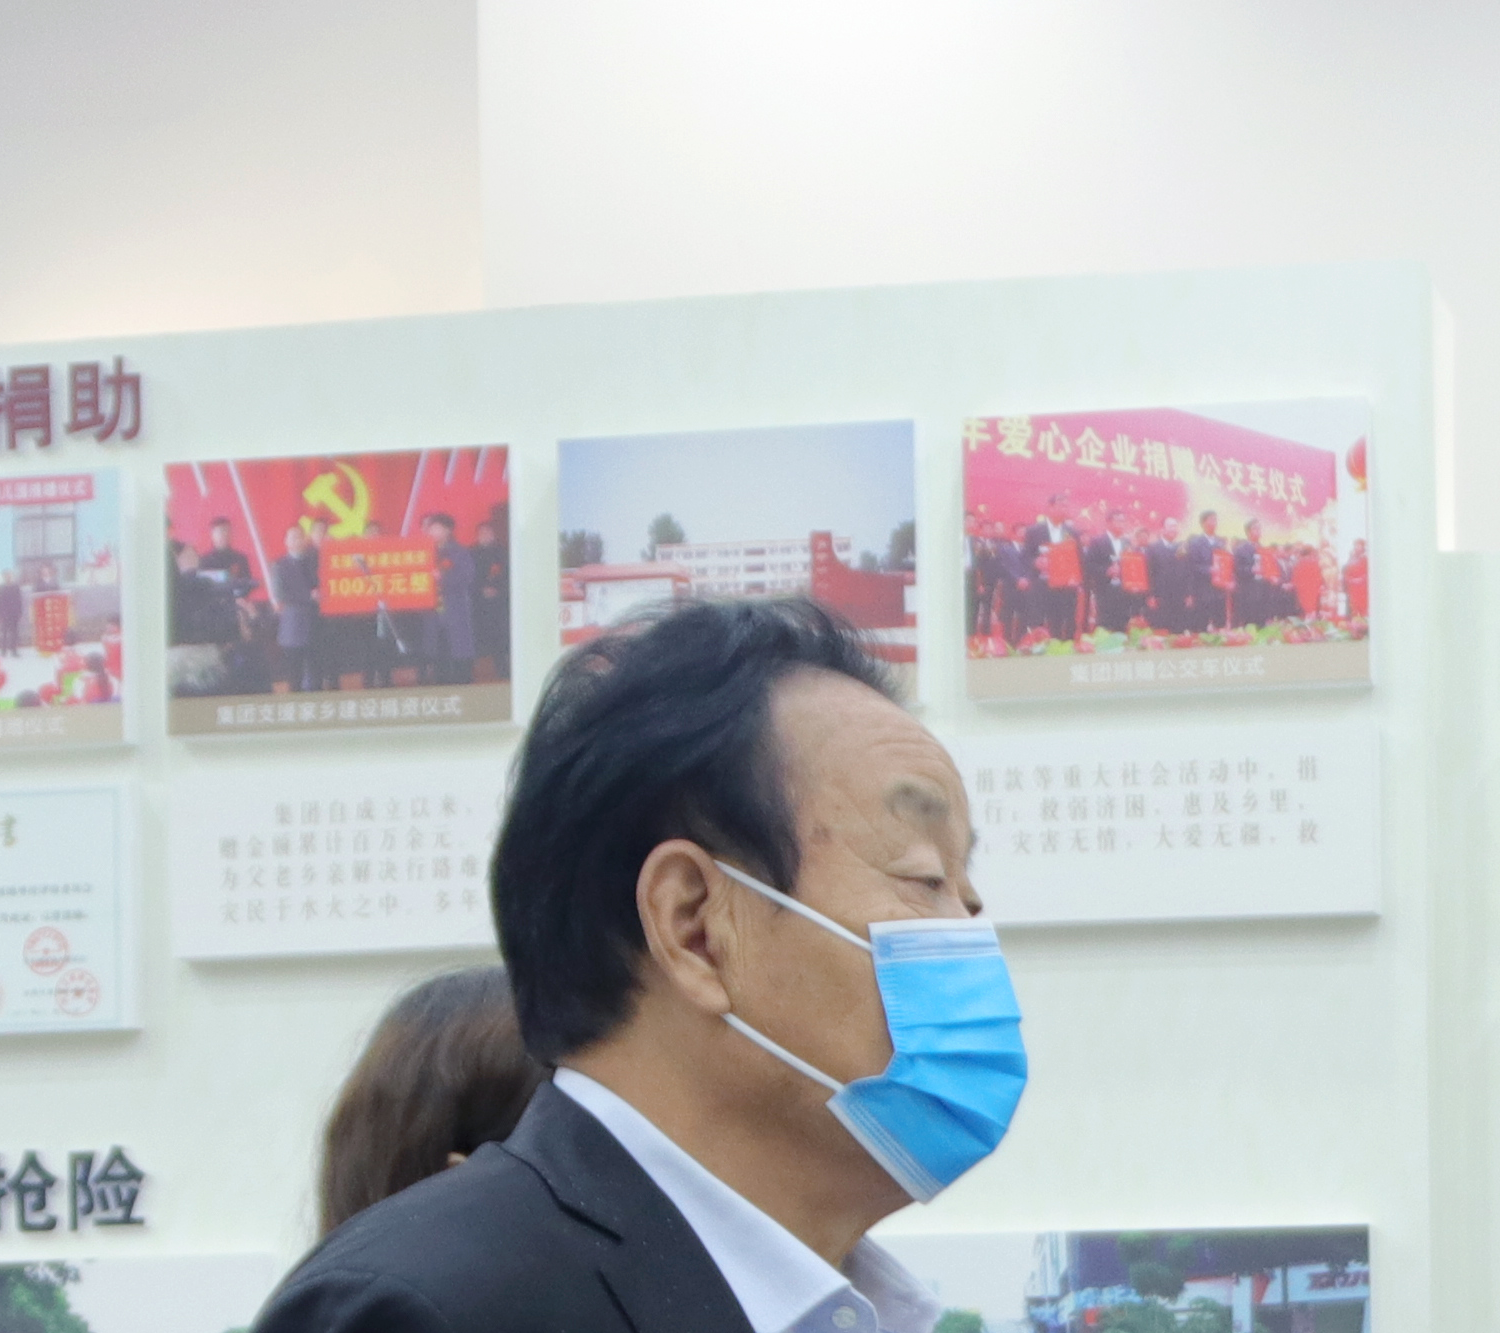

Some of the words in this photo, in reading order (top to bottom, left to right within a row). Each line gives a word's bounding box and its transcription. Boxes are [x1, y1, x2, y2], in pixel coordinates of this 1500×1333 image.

[1070, 654, 1266, 684] 集团捐赠公交车仪式
[274, 794, 503, 826] 集团自成立以来，
